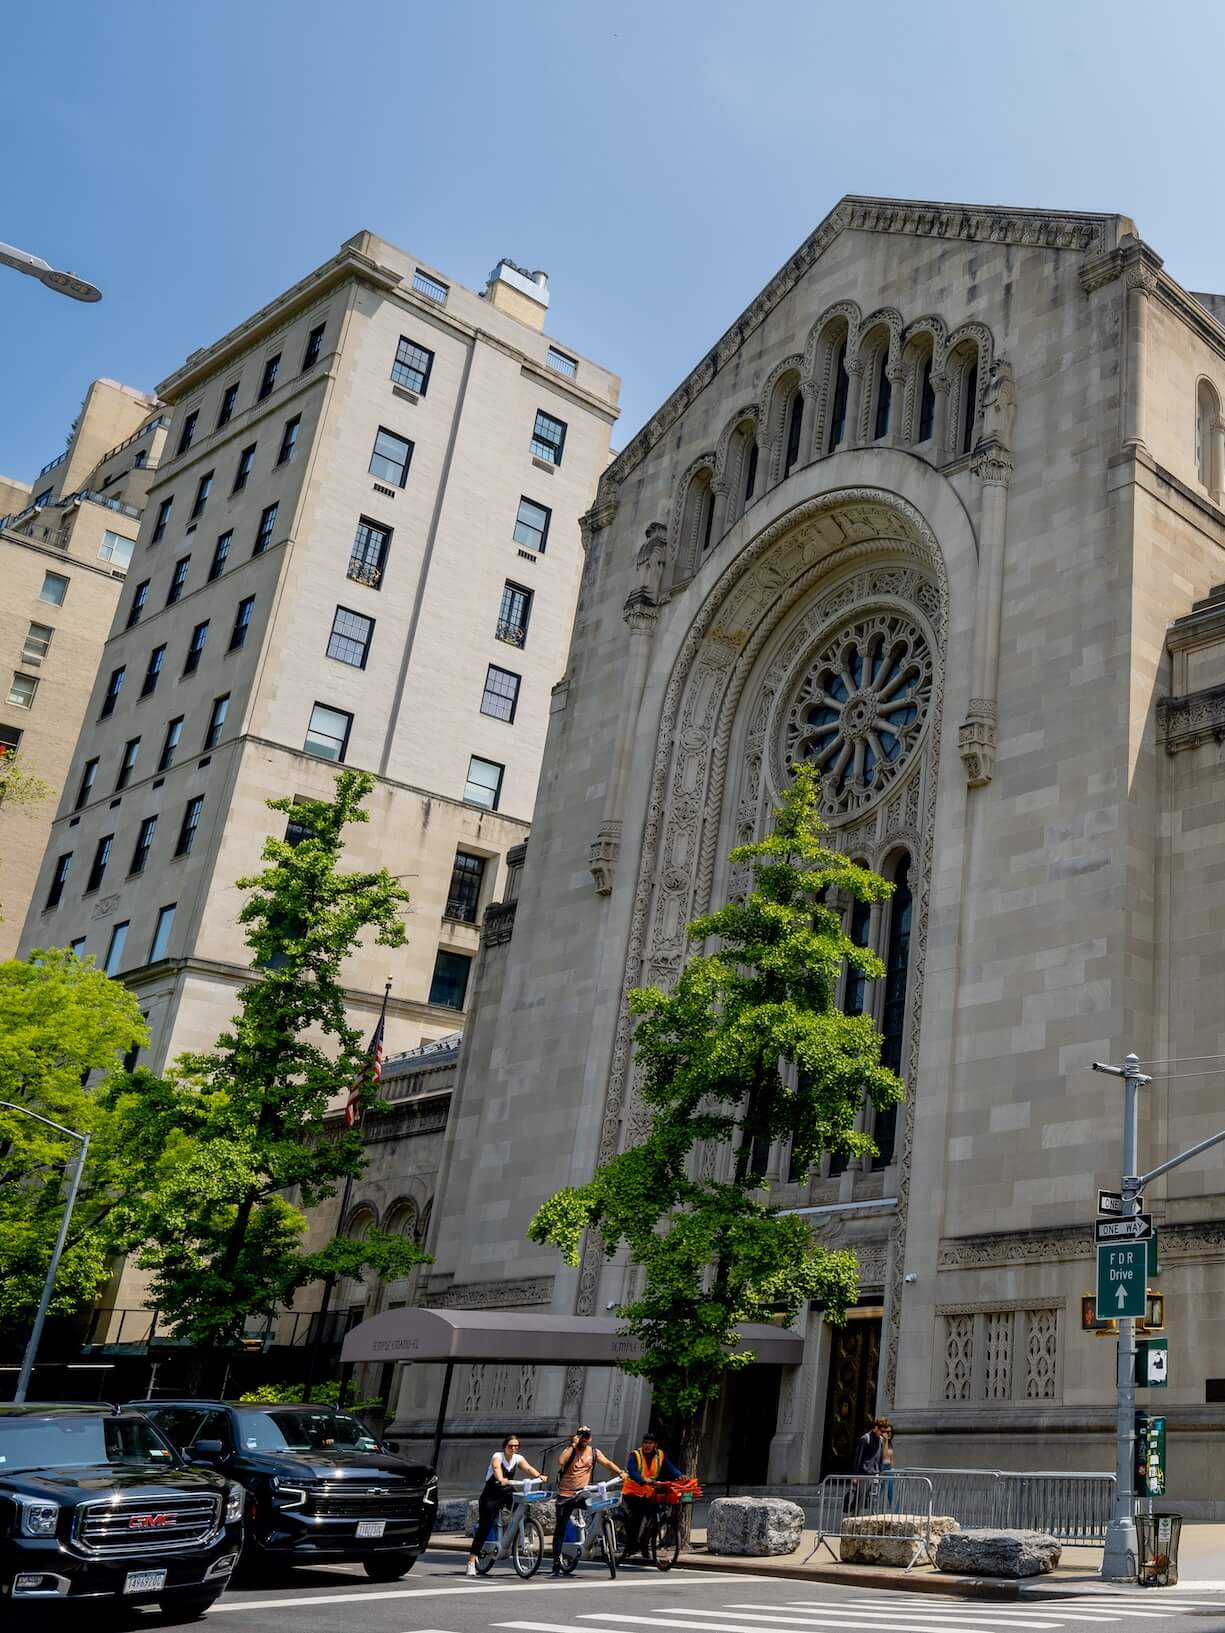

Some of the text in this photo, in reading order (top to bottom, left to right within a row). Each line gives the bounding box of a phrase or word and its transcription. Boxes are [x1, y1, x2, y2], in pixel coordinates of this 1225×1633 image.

[1105, 1198, 1120, 1209] ONE
[1103, 1221, 1143, 1234] ONE WAY
[1110, 1269, 1133, 1281] Drive
[610, 1342, 638, 1353] TEMPLE
[129, 1513, 177, 1528] GMC
